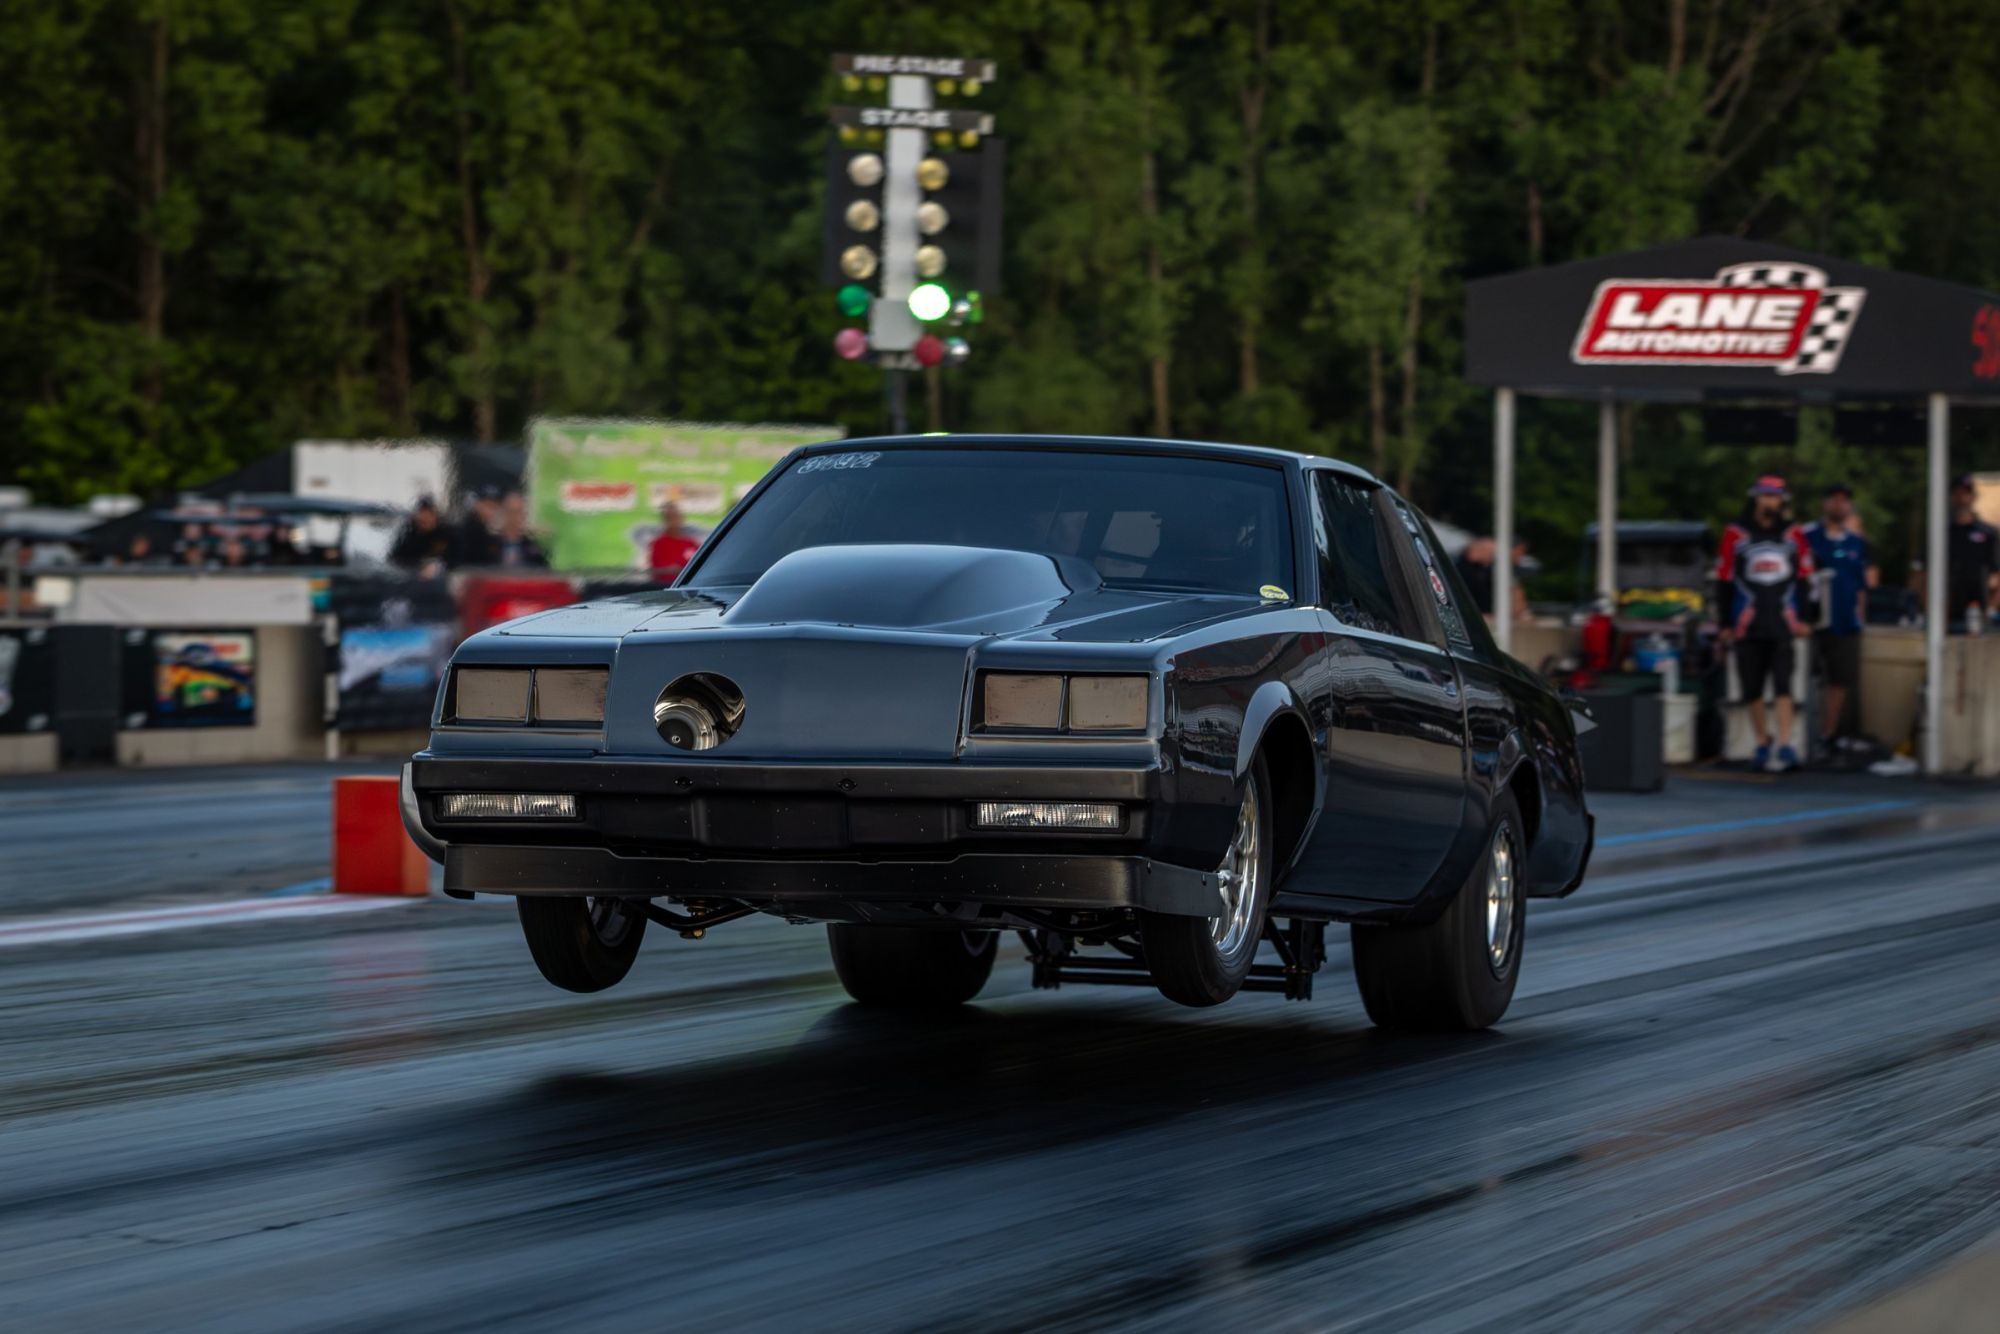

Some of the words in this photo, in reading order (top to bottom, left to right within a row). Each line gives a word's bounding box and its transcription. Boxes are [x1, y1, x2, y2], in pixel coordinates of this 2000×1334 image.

[853, 55, 964, 75] PRE-STAGE
[860, 108, 950, 127] STAGE
[1606, 293, 1803, 328] LANE
[1592, 330, 1791, 354] AUTOMOTIVE
